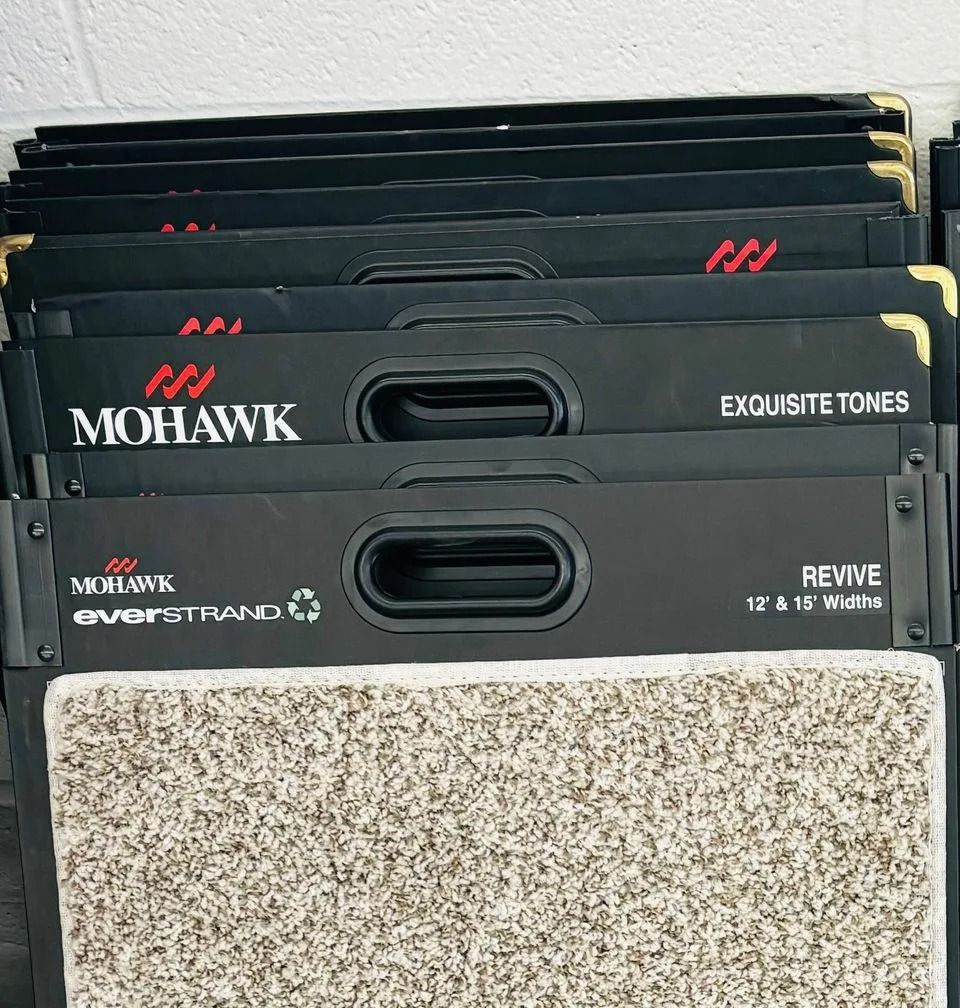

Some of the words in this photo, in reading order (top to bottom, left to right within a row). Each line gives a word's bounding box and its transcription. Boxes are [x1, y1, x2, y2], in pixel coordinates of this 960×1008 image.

[720, 393, 834, 417] EXQUISITE
[836, 390, 910, 414] TONES
[68, 403, 302, 446] MOHAWK
[69, 574, 176, 595] MOHAWK
[802, 563, 882, 588] REVIVE
[746, 595, 770, 612] 12'
[775, 595, 789, 612] &
[793, 594, 818, 611] 15'
[822, 593, 883, 610] Widths
